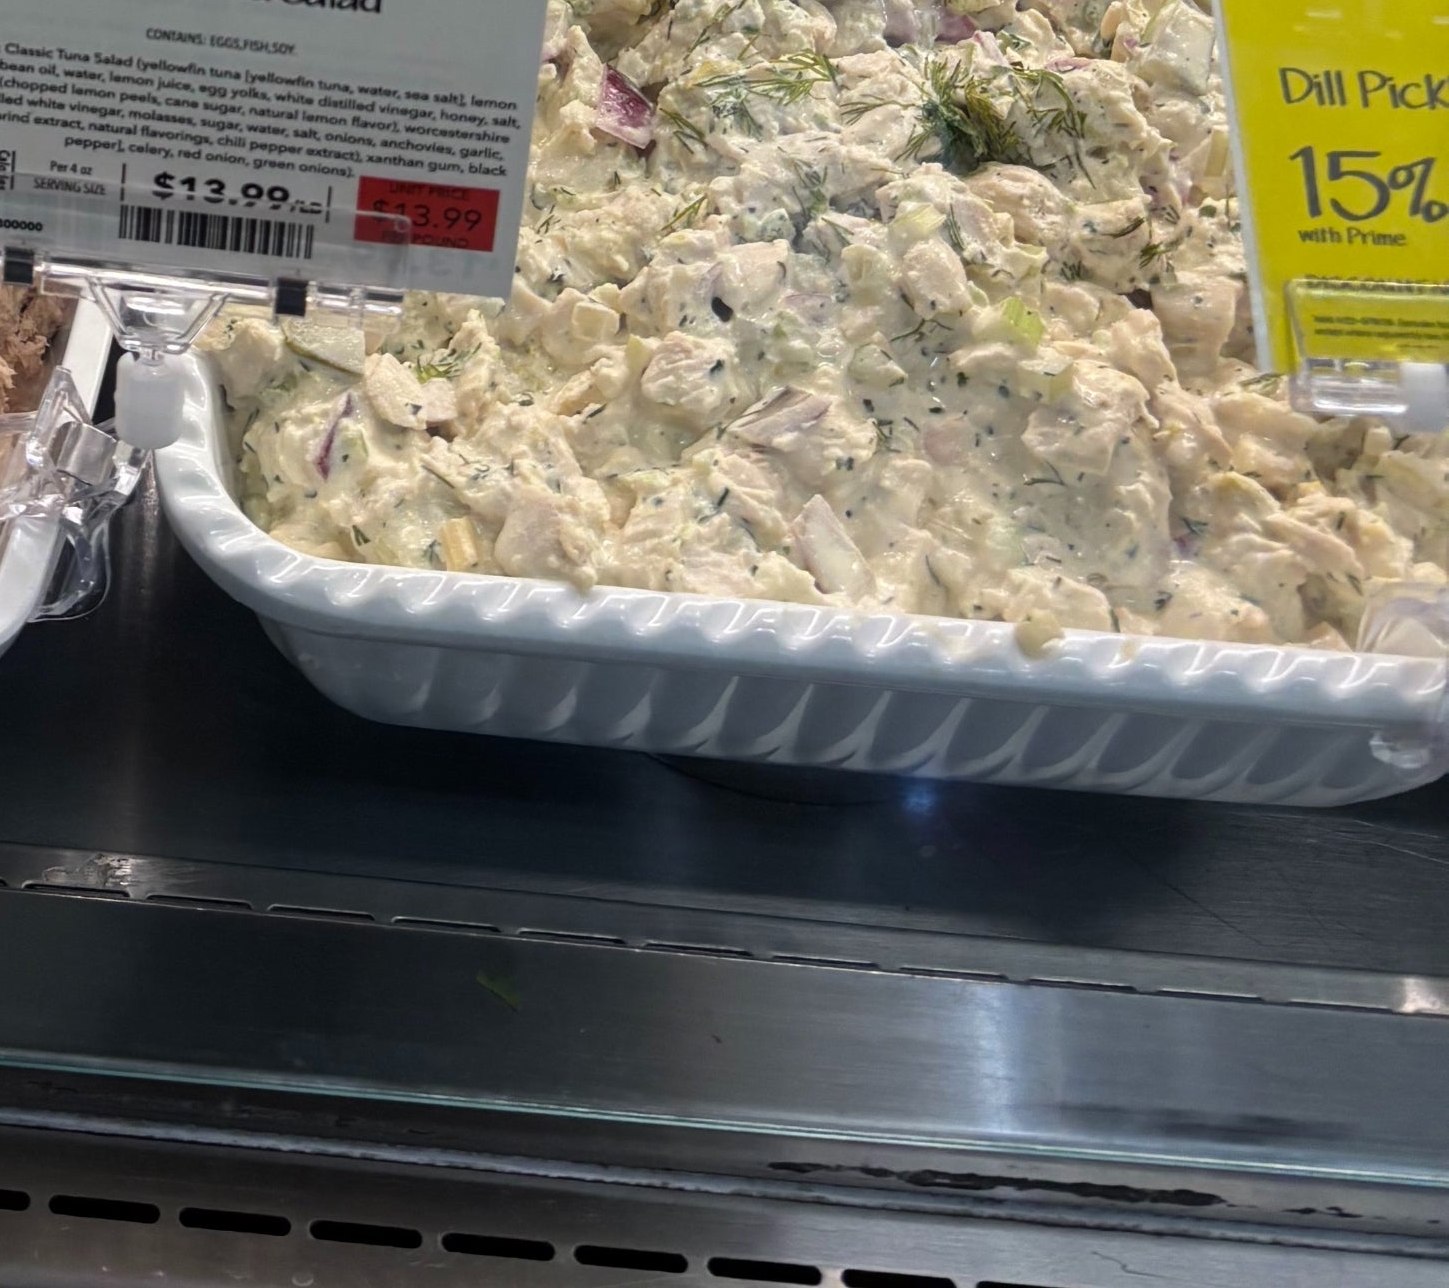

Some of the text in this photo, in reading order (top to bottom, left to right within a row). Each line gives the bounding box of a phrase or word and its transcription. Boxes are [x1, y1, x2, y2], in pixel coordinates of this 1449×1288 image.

[1279, 68, 1449, 111] Dill Pick
[49, 160, 92, 175] Per 4 oz
[33, 177, 105, 195] SERVING SIZE
[1289, 146, 1449, 223] 15%
[1298, 227, 1407, 247] with Prime
